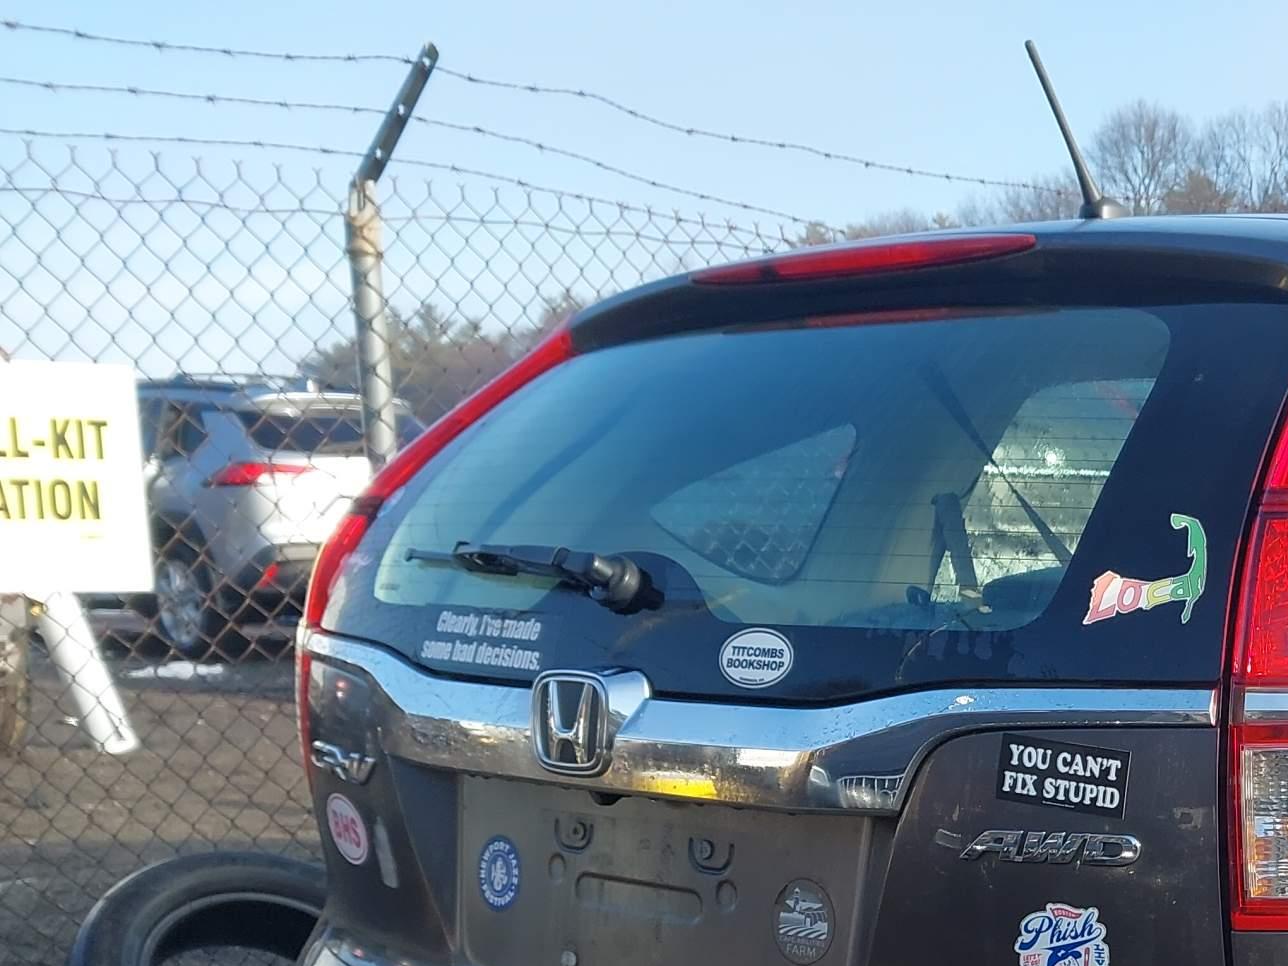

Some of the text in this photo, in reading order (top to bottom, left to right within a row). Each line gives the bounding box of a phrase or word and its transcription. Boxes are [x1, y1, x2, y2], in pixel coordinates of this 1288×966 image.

[0, 416, 108, 460] L-KIT
[437, 610, 542, 641] Clearly, I've made
[421, 640, 540, 671] some bad decisions.
[726, 658, 785, 672] BOOKSHOP
[732, 646, 785, 659] TITCOMBS
[1009, 743, 1122, 781] YOU CAN'T
[1001, 771, 1121, 809] FIX STUPID
[960, 829, 1142, 868] AWD
[1018, 911, 1102, 951] Phish
[786, 943, 816, 958] FARM
